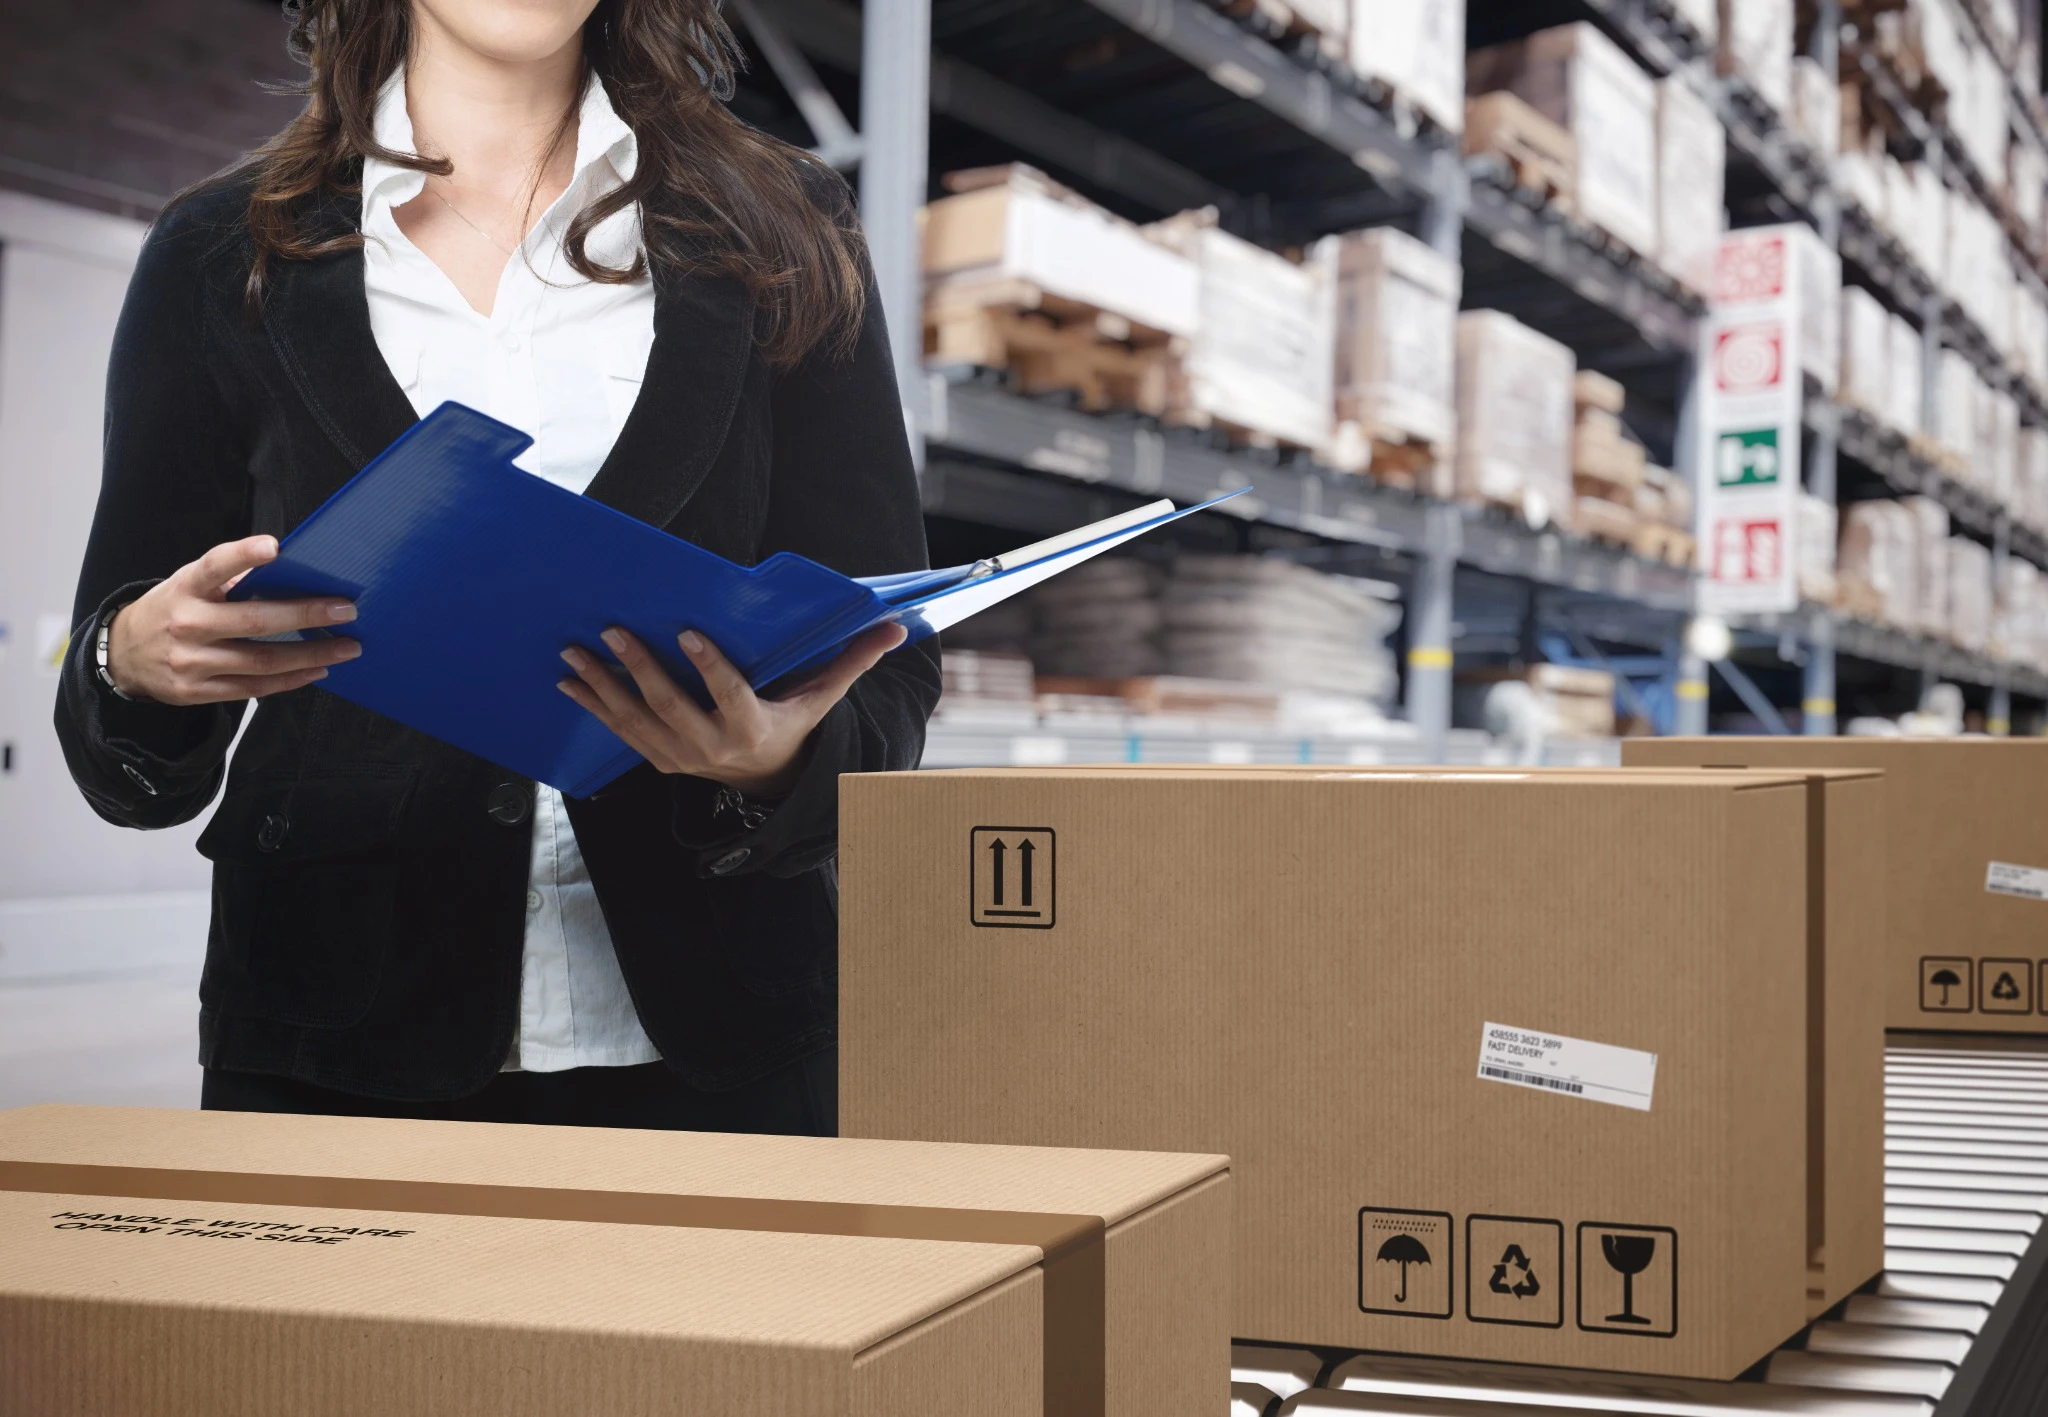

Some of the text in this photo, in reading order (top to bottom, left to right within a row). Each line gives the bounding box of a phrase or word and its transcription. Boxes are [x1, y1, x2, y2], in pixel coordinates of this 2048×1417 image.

[1488, 1040, 1544, 1059] FAST DELIVERY
[50, 1212, 416, 1238] HANDLE WITH CARE
[54, 1222, 351, 1244] OPEN THIS SIDE
